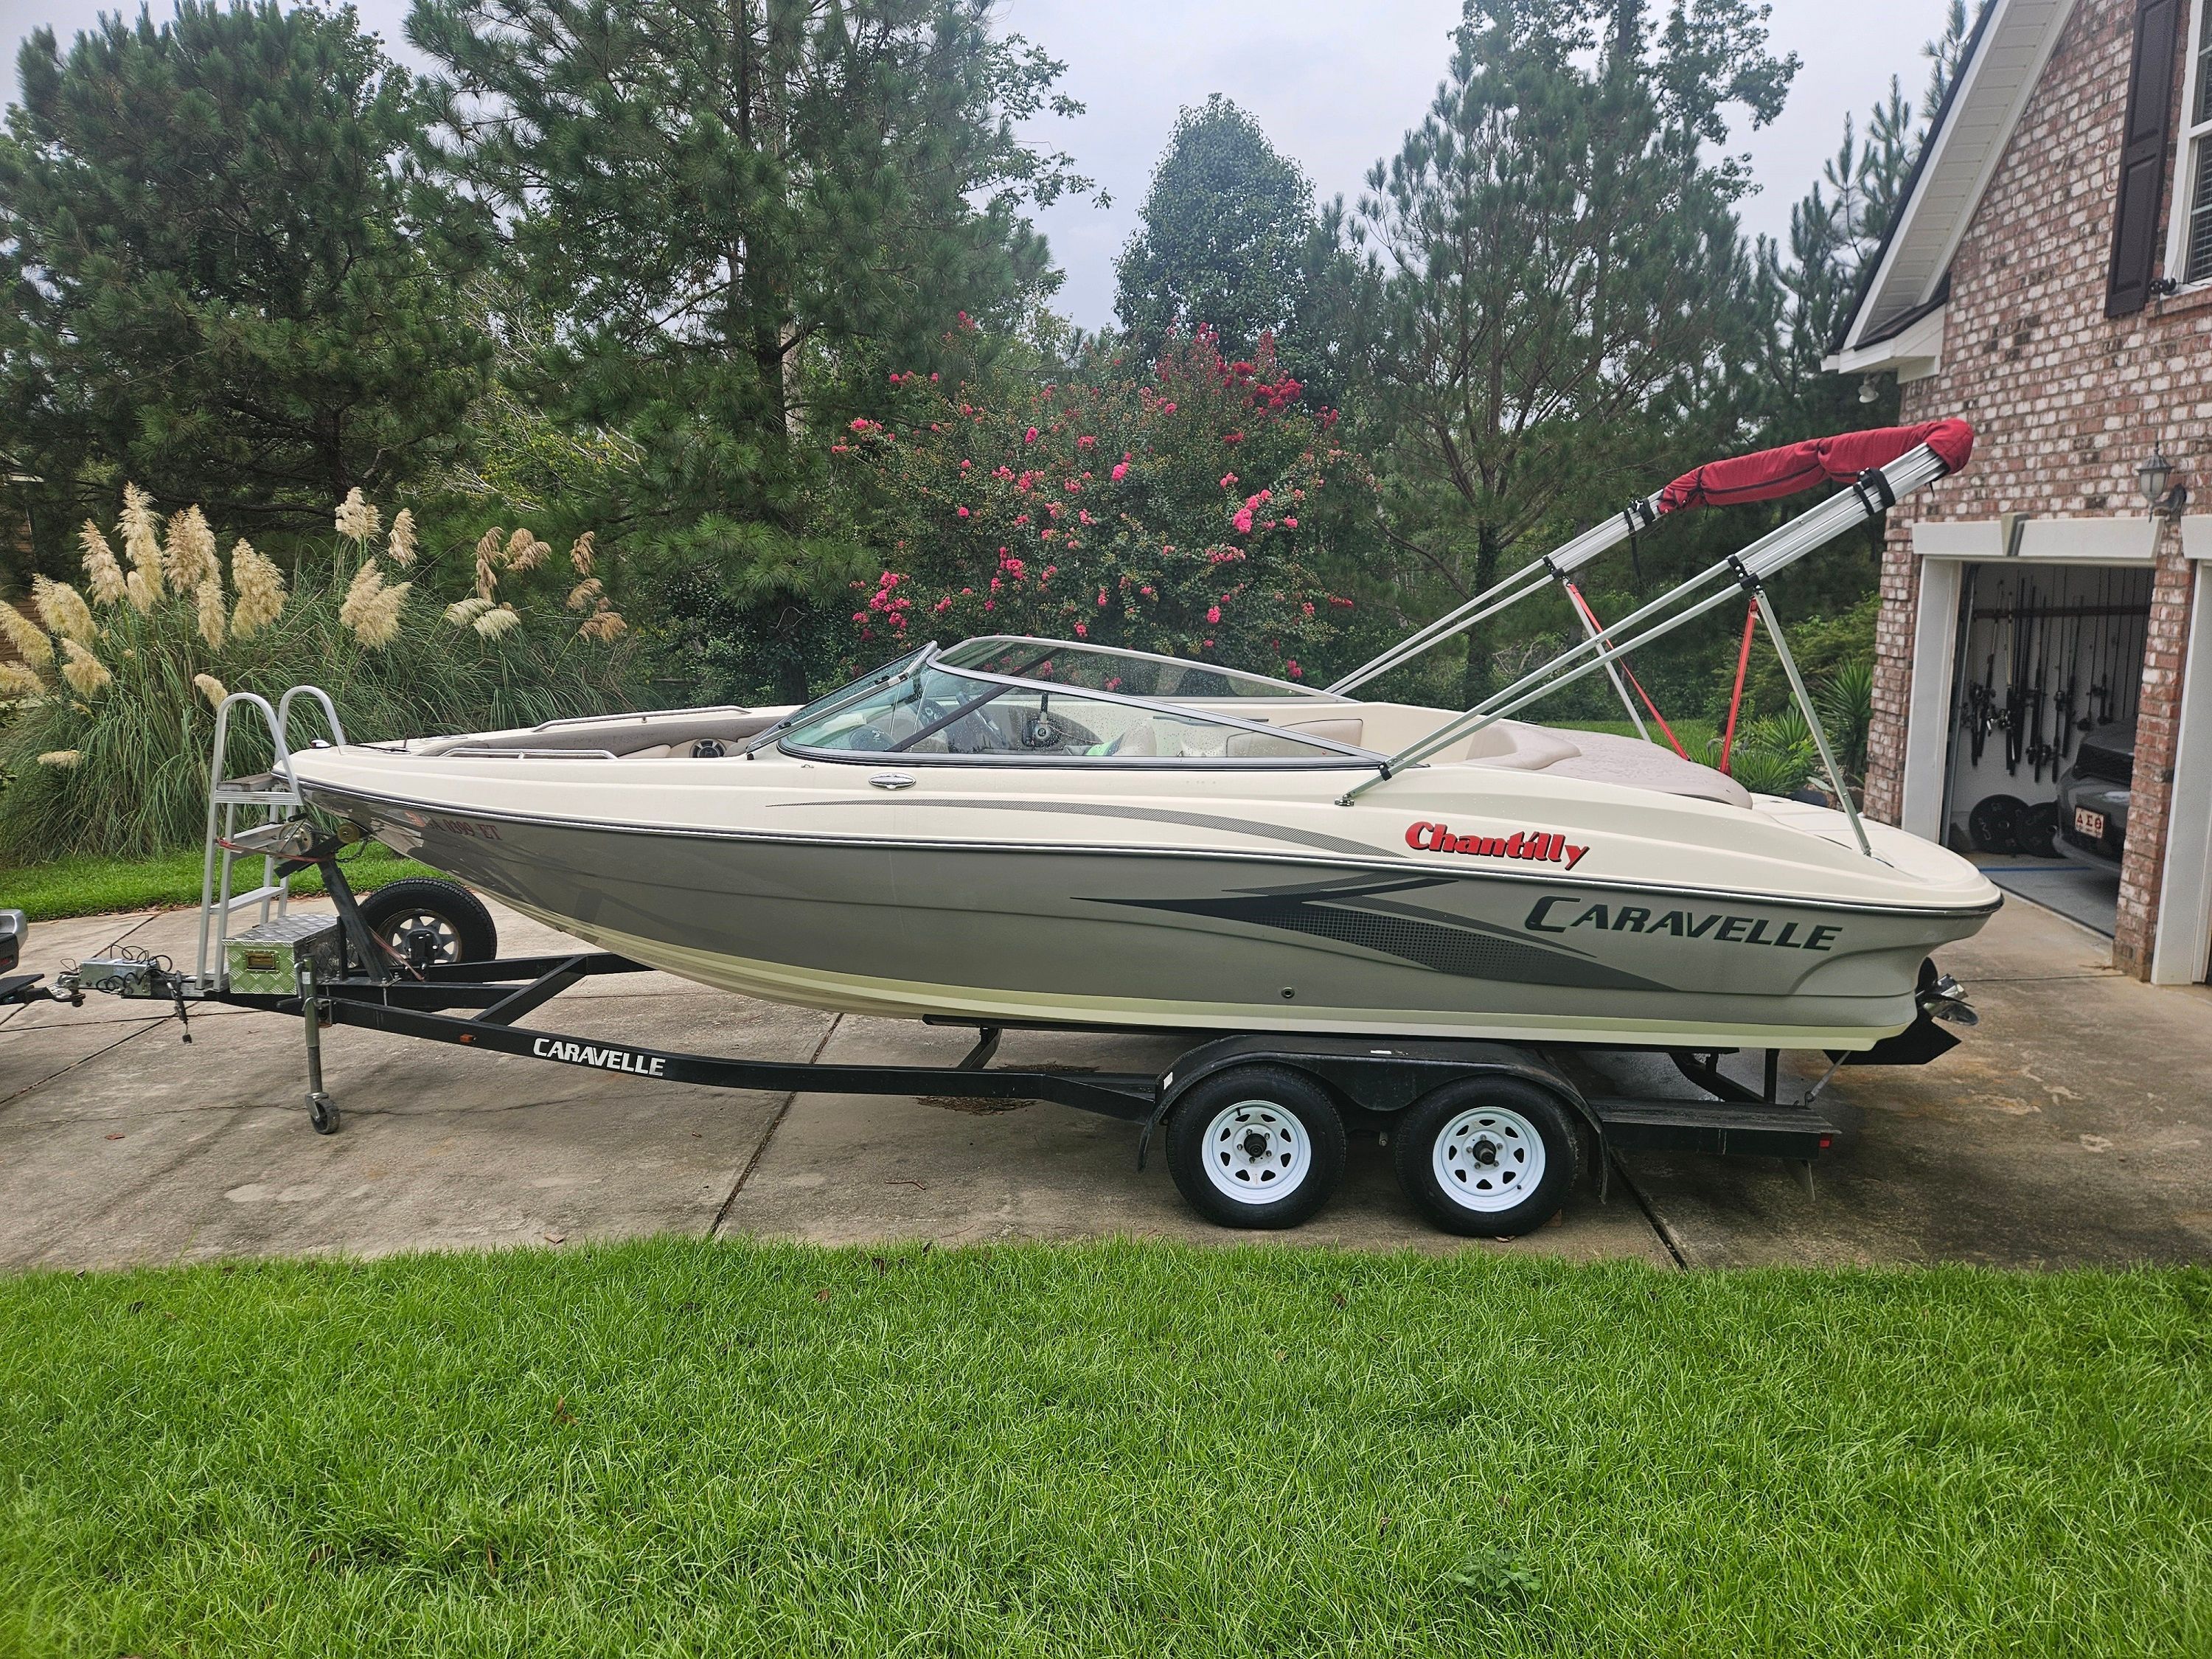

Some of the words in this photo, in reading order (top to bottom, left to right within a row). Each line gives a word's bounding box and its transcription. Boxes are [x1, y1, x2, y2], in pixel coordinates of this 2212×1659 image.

[1405, 821, 1590, 871] Chantilly
[1524, 895, 1843, 951] CARAVELLE
[532, 1037, 667, 1077] CARAVELLE
